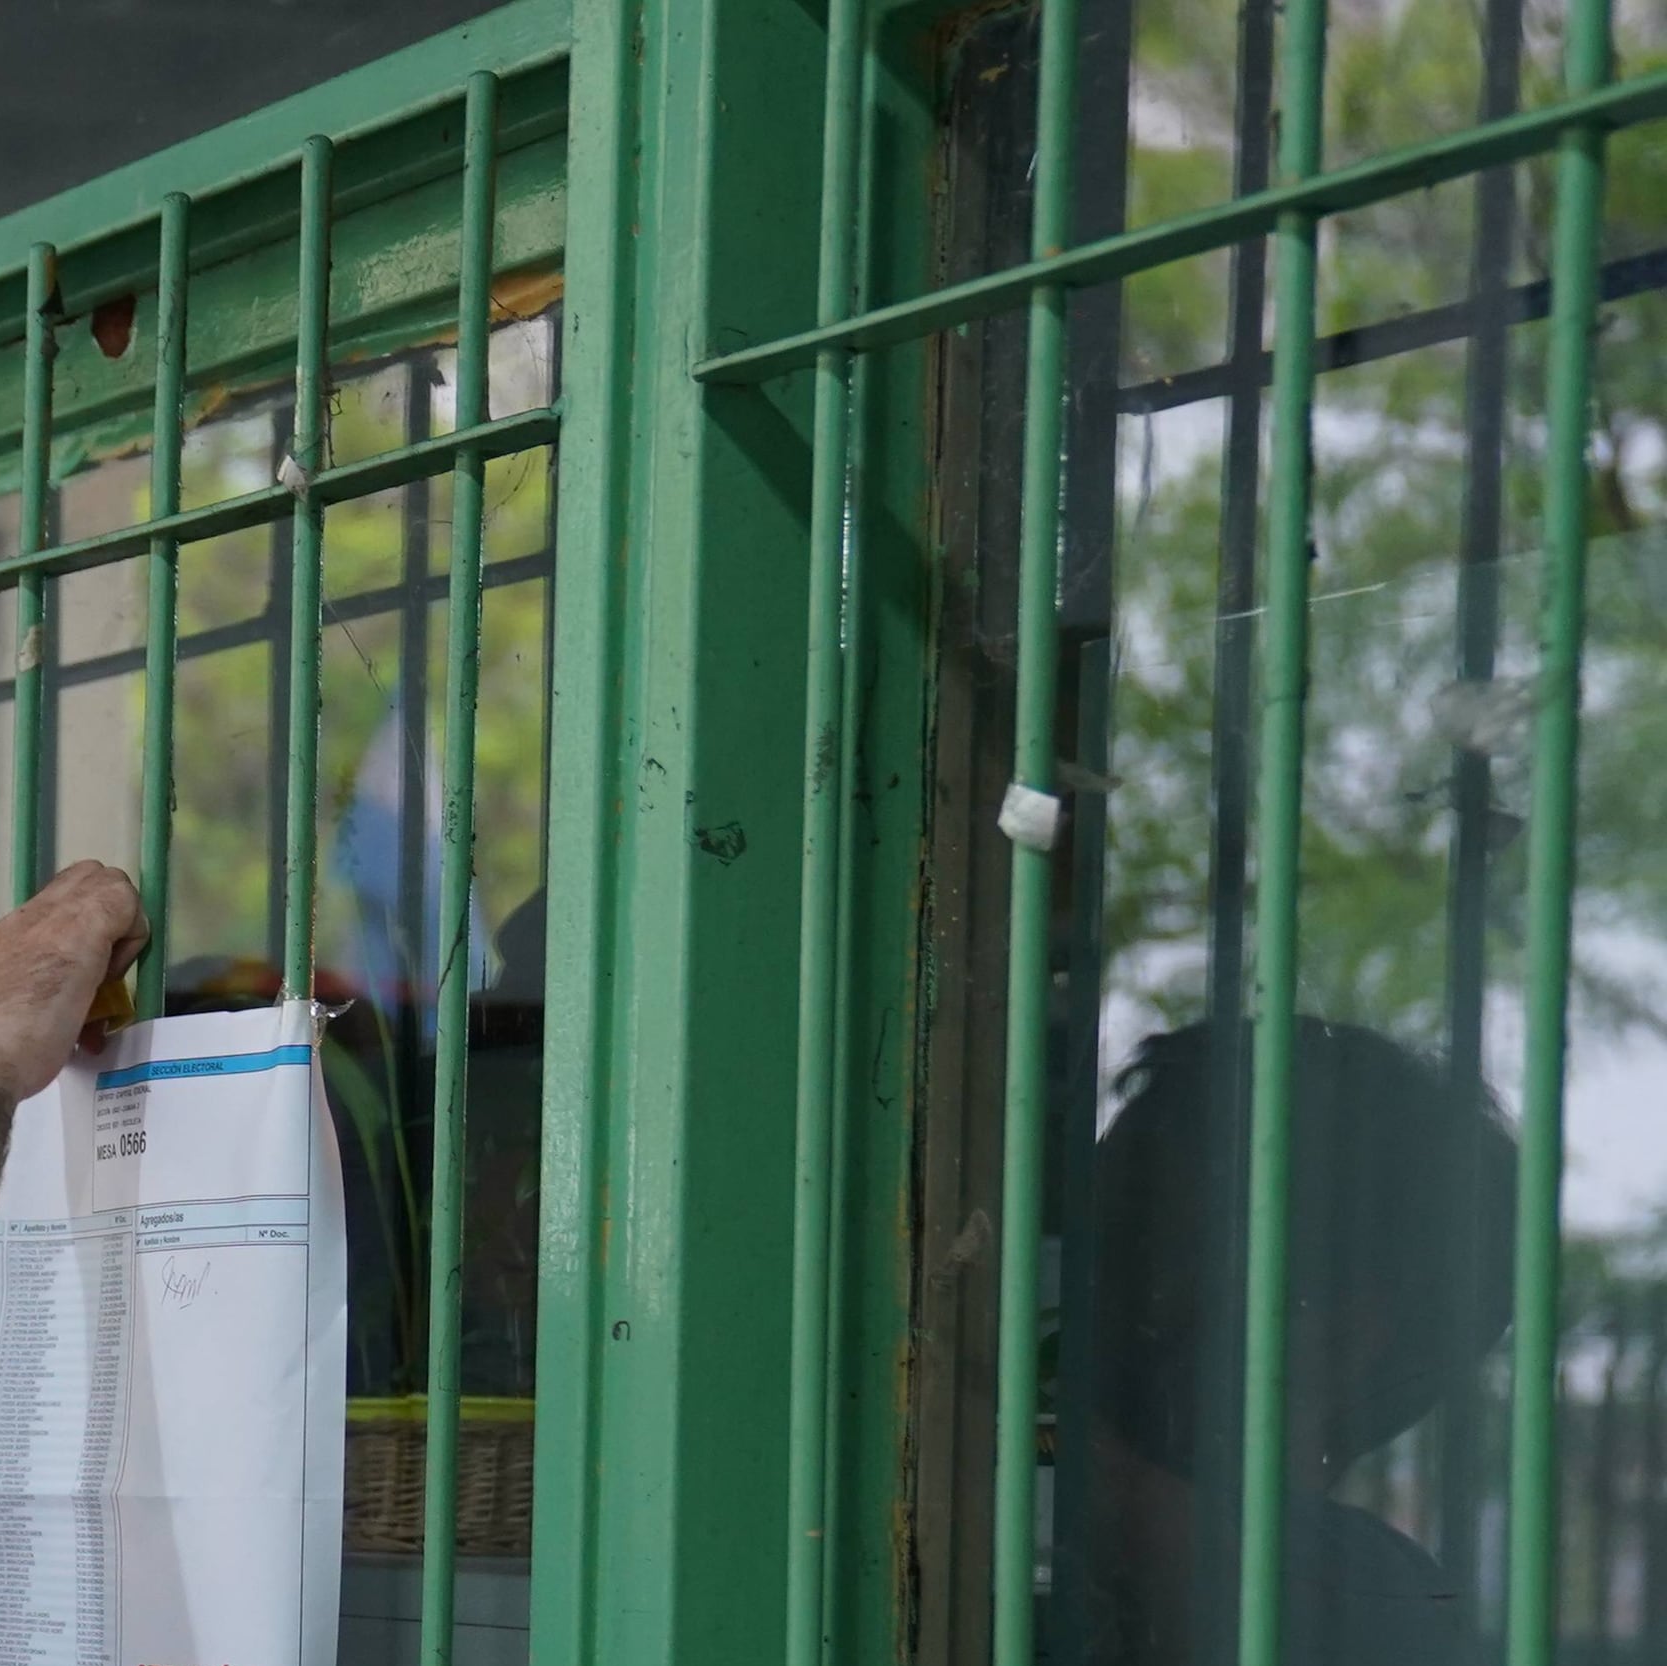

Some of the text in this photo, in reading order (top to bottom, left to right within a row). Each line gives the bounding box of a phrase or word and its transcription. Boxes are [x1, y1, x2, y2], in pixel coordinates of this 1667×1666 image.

[151, 1060, 224, 1076] SECCIÓN ELECTORAL
[96, 1130, 147, 1161] MESA 0566
[140, 1210, 184, 1229] Agregados/as
[269, 1229, 290, 1239] Doc.
